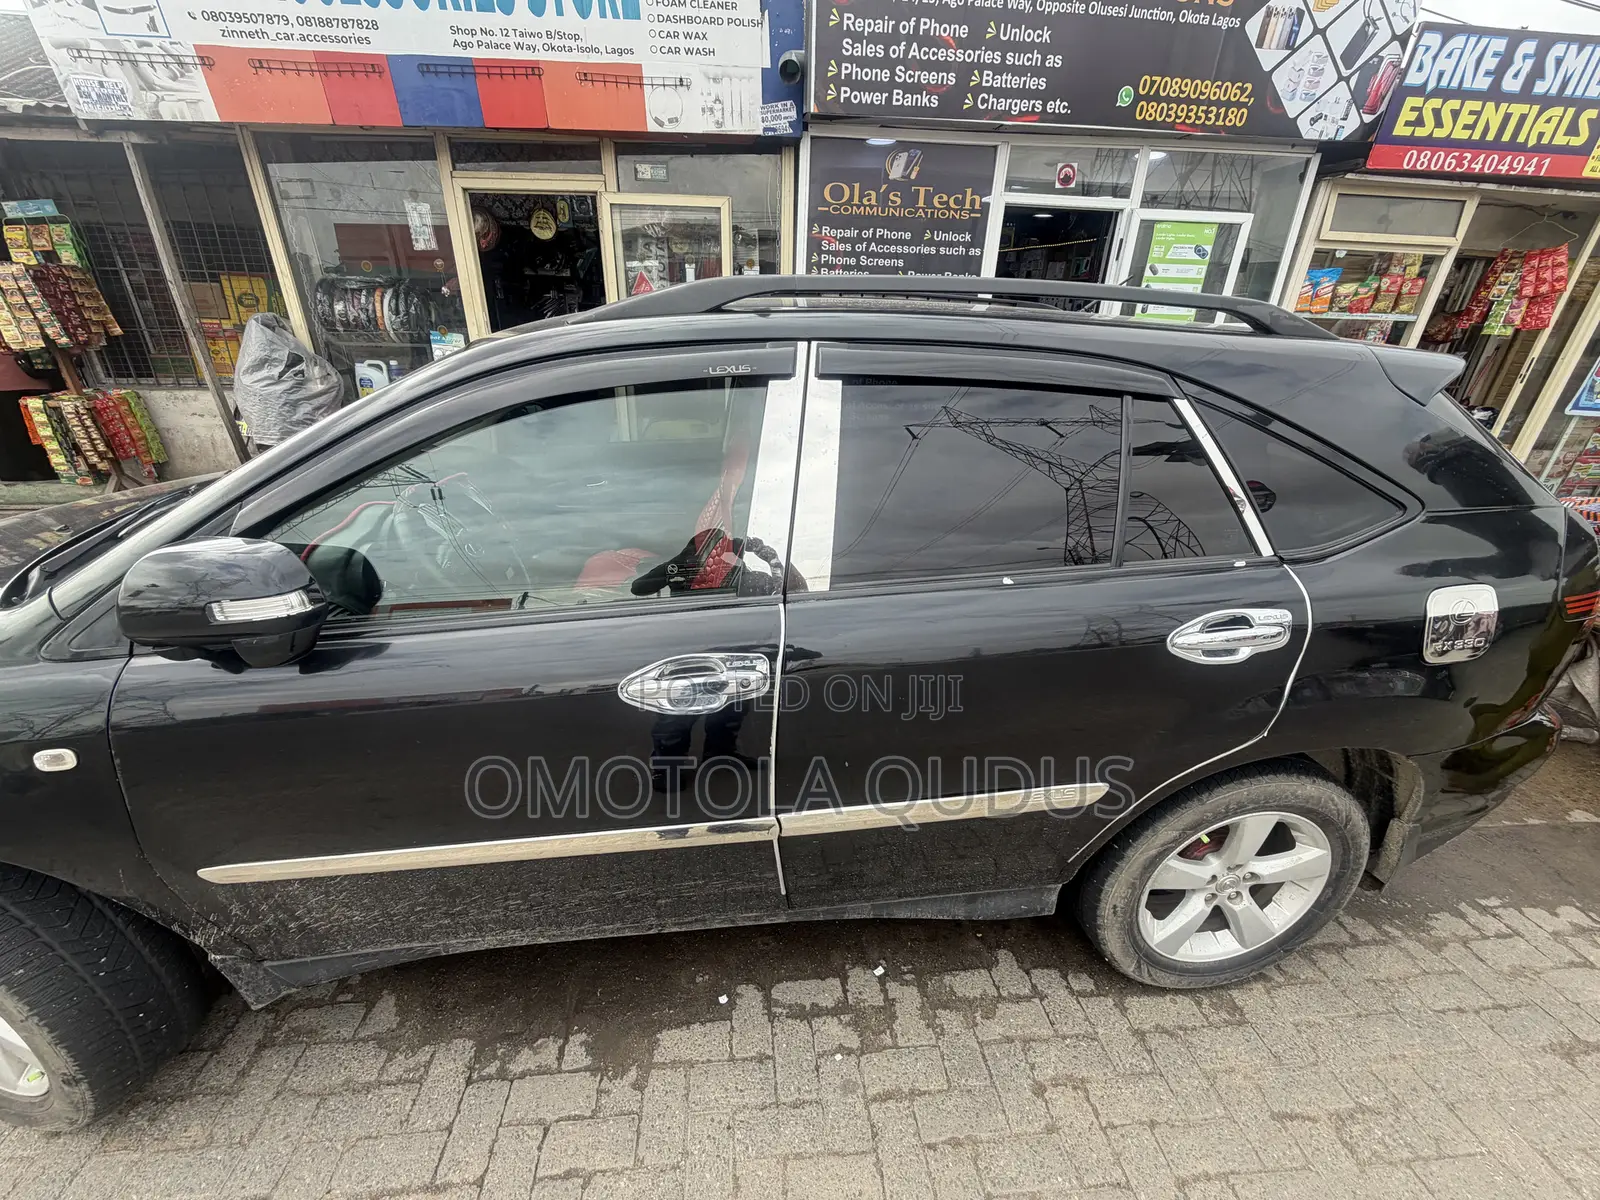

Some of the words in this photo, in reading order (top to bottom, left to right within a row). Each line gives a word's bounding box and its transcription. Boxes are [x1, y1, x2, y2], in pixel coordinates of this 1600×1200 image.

[690, 0, 738, 11] CLEANER
[1007, 0, 1033, 14] Way,
[1036, 0, 1086, 15] Opposite
[1088, 1, 1127, 17] Olusesi
[1129, 7, 1176, 24] Junction,
[1179, 9, 1210, 25] Okota
[1212, 13, 1241, 30] Lagos
[201, 10, 294, 28] 08039507879,
[297, 16, 379, 31] 08188787828
[657, 14, 724, 26] DASHBOARD
[727, 17, 763, 28] POLISH
[843, 12, 895, 36] Repair
[899, 17, 916, 35] of
[919, 18, 969, 38] Phone
[999, 23, 1052, 43] Unlock
[219, 27, 372, 45] zinneth_car.accessories
[450, 25, 477, 38] Shop
[480, 27, 497, 37] No.
[500, 28, 510, 38] 12
[512, 29, 543, 40] Taiwo
[546, 30, 583, 42] B/Stop,
[658, 29, 680, 40] CAR
[683, 31, 708, 41] WAX
[453, 38, 474, 50] Ago
[477, 40, 511, 51] Palace
[513, 41, 540, 53] Way,
[542, 43, 603, 55] Okota-Isolo,
[605, 45, 635, 56] Lagos
[659, 45, 681, 56] CAR
[683, 46, 716, 57] WASH
[841, 38, 887, 58] Sales
[889, 41, 906, 59] of
[908, 42, 1001, 64] Accessories
[1005, 50, 1042, 66] such
[1045, 54, 1063, 68] as
[1402, 31, 1509, 95] BAKE
[1500, 39, 1539, 94] &
[841, 62, 891, 82] Phone
[895, 65, 956, 86] Screens
[982, 70, 1047, 90] Batteries
[1138, 74, 1255, 107] 07089096062,
[840, 87, 888, 106] Power
[892, 89, 939, 107] Banks
[977, 92, 1043, 115] Chargers
[1046, 98, 1072, 114] etc.
[1135, 101, 1248, 127] 08039353180
[1392, 96, 1599, 148] ESSENTIALS
[1402, 150, 1551, 177] 08063404941
[823, 182, 901, 207] Ola's
[911, 186, 982, 210] Tech
[829, 205, 970, 220] COMMUNICATIONS
[821, 226, 859, 240] Repair
[862, 227, 873, 238] of
[876, 228, 912, 240] Phone
[934, 231, 972, 242] Unlock
[821, 240, 852, 251] Sales
[855, 242, 867, 252] of
[869, 242, 936, 255] Accessories
[939, 245, 966, 256] such
[968, 247, 982, 256] as
[820, 254, 857, 266] Phone
[859, 256, 904, 267] Screens
[708, 364, 751, 375] LEXUS
